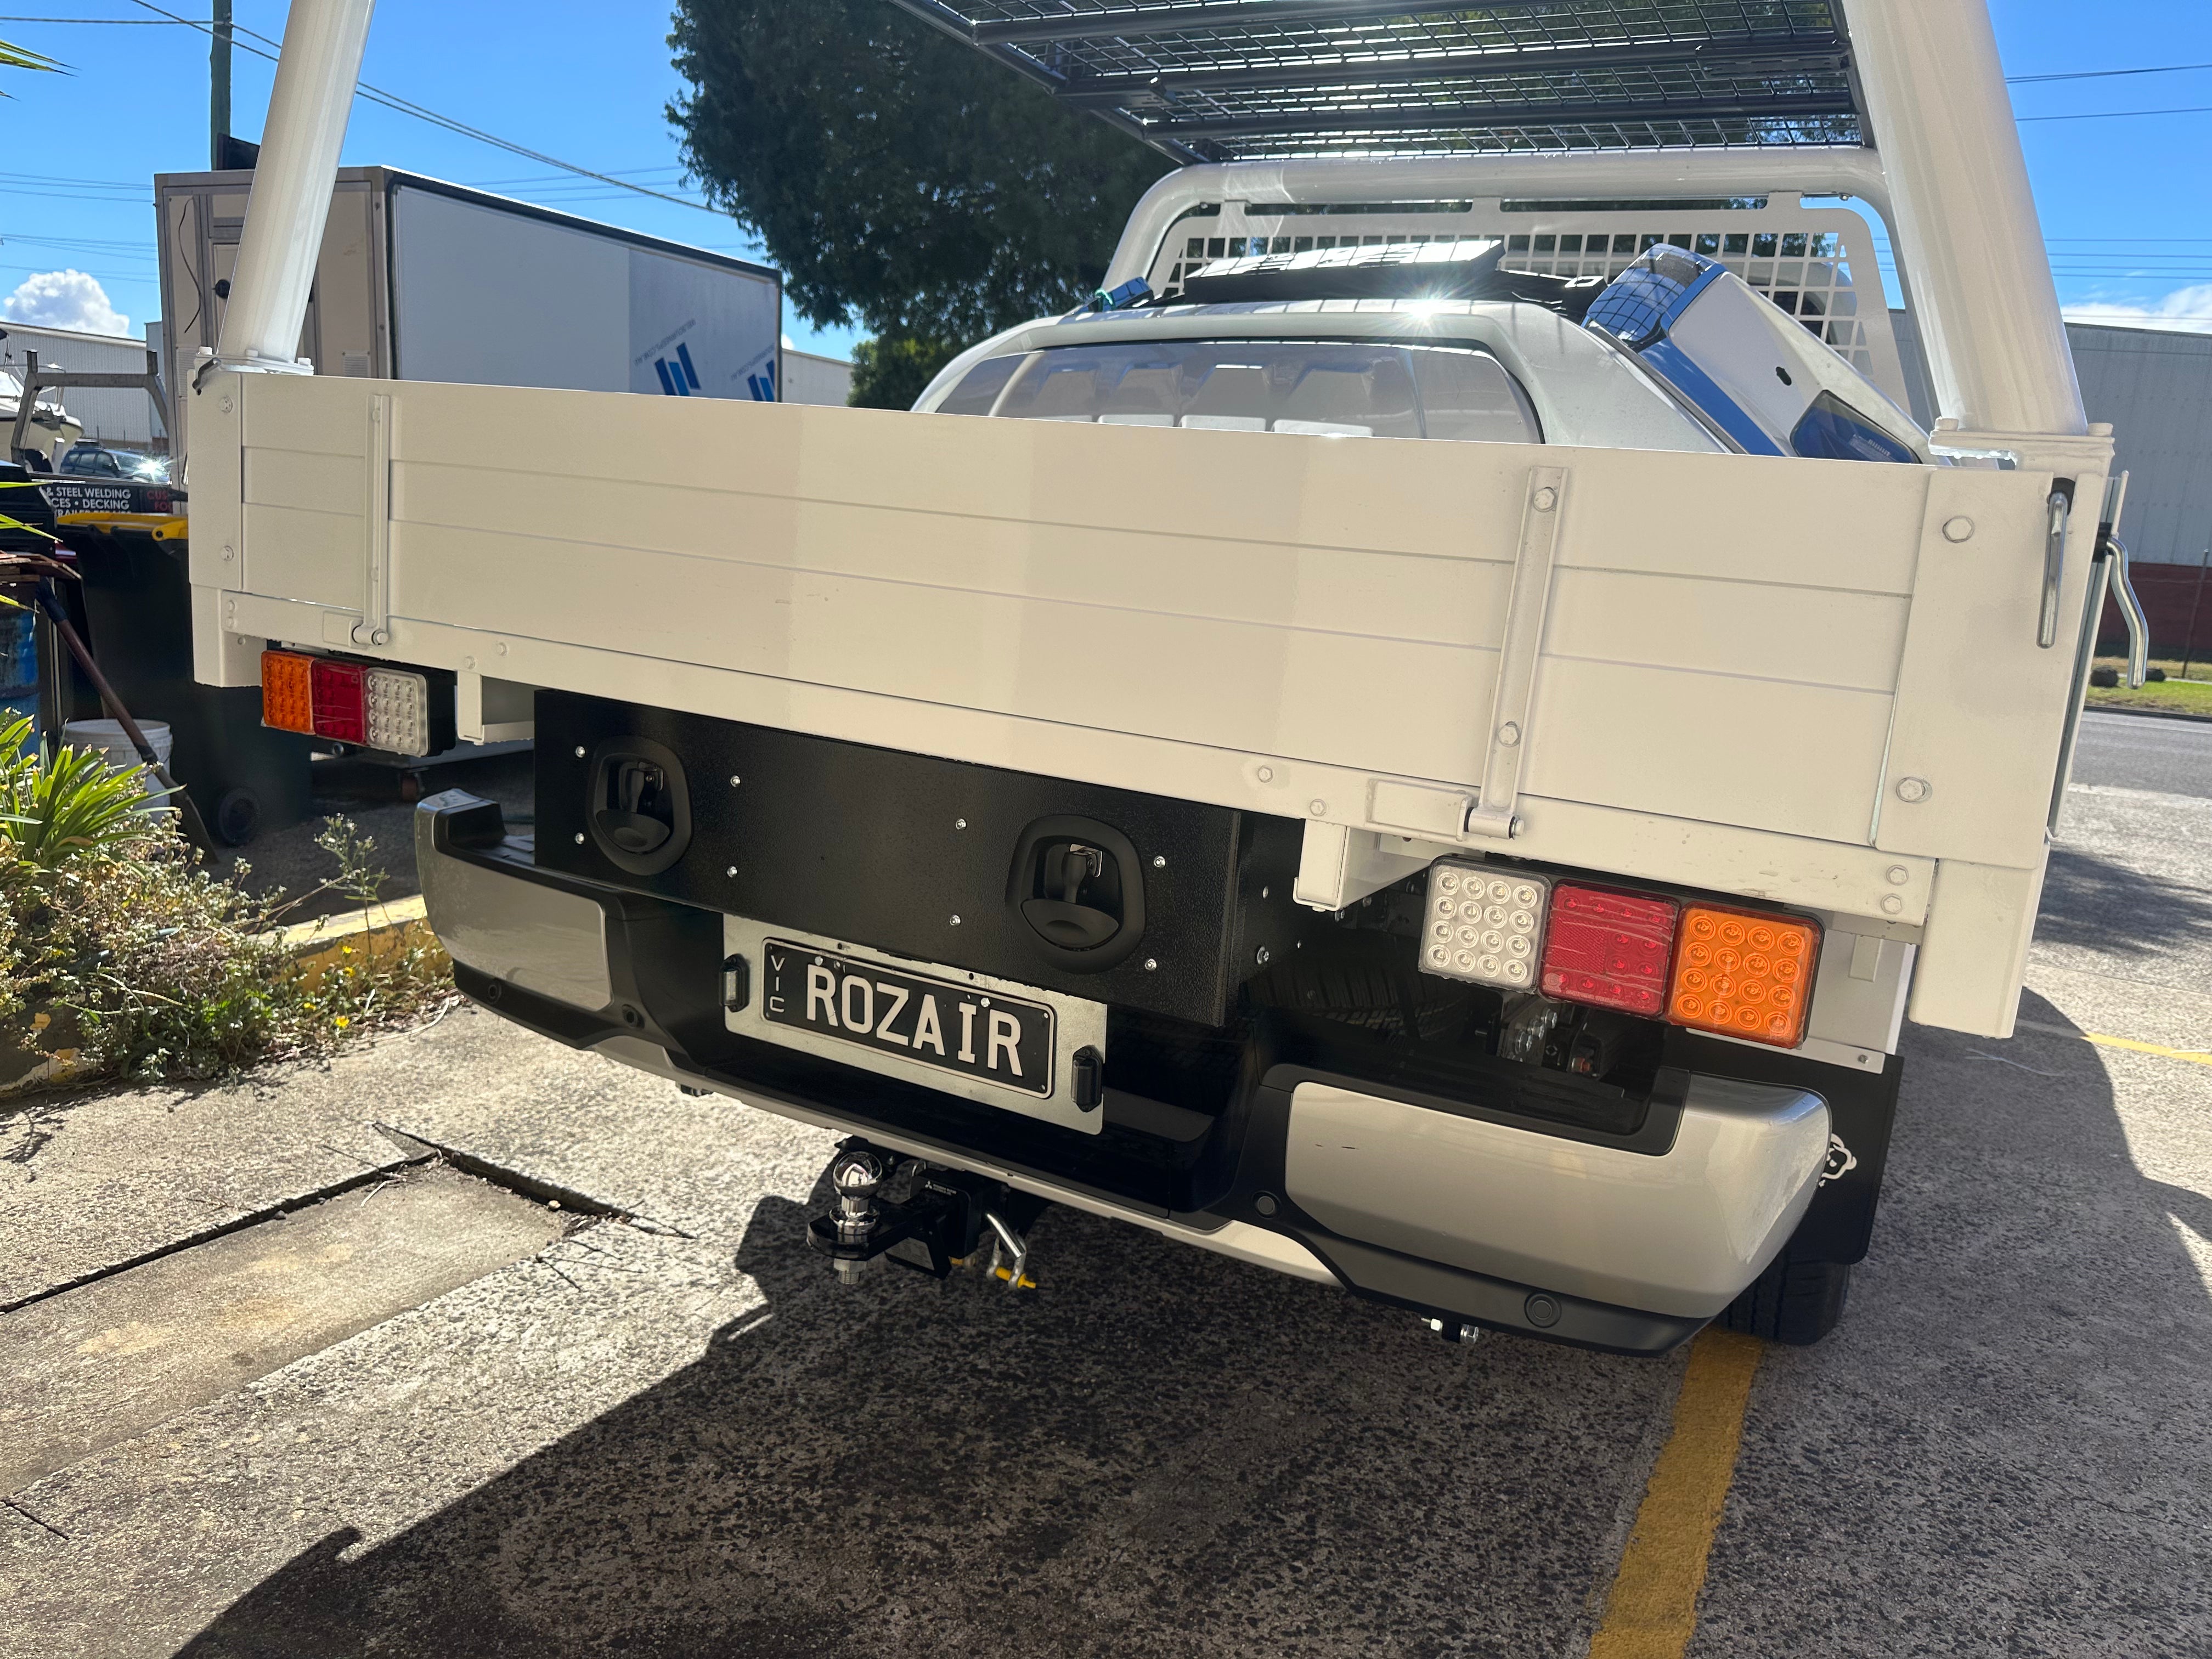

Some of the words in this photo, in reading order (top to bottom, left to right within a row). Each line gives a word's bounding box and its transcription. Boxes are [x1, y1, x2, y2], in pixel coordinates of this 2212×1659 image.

[46, 486, 54, 496] &
[57, 486, 83, 498] STEEL
[84, 488, 131, 499] WELDING
[82, 499, 129, 510] DECKING
[769, 955, 785, 1013] VIC
[806, 963, 1023, 1077] ROZAIR
